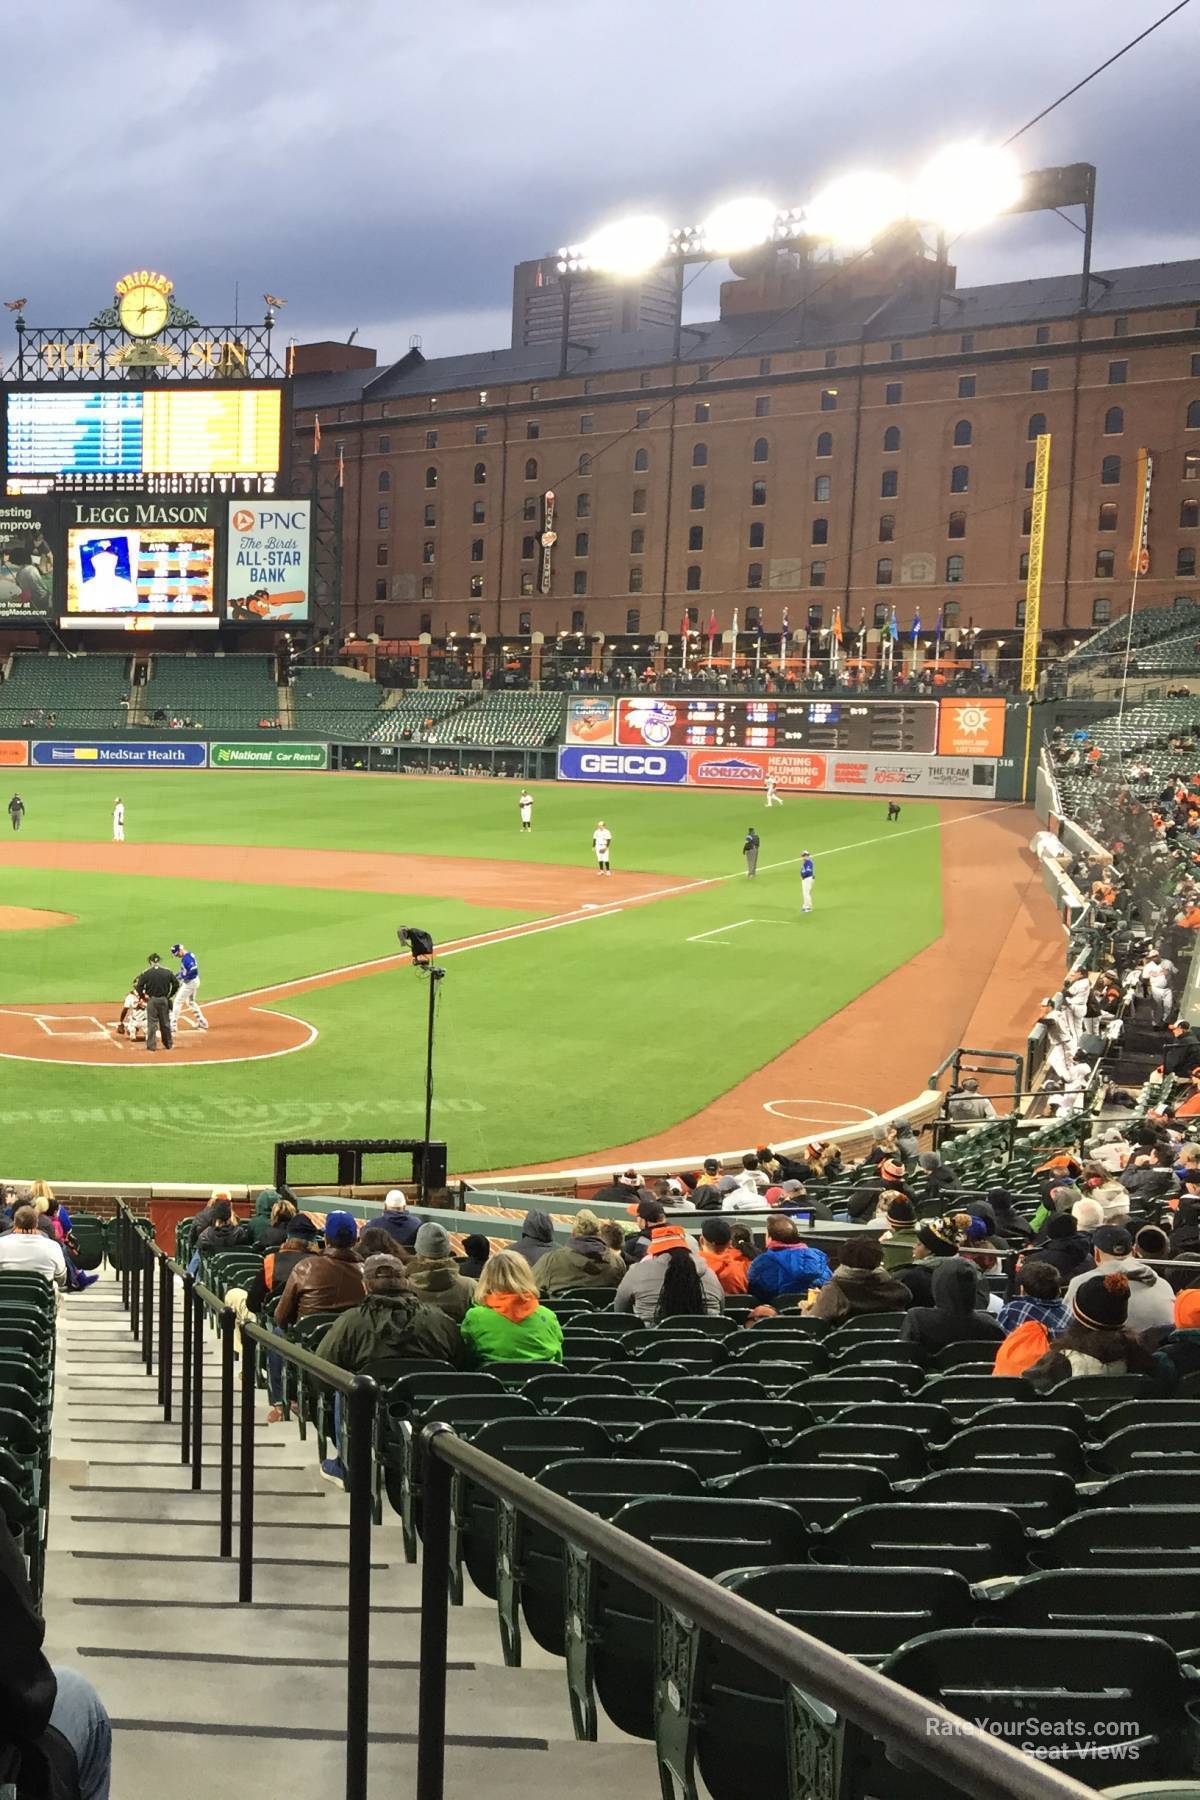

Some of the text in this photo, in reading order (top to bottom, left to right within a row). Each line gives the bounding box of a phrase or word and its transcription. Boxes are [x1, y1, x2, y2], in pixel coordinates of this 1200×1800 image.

[115, 270, 174, 295] ORIOLES
[41, 341, 247, 369] THE SUN
[75, 504, 208, 524] LEGG MASON
[259, 512, 307, 530] PNC
[240, 536, 298, 549] The Birds
[236, 551, 301, 566] ALL-STAR
[250, 568, 285, 583] BANK
[100, 750, 185, 760] MedStar Health
[230, 750, 320, 761] National Car Rental
[768, 756, 812, 767] HEATING
[580, 754, 667, 775] GEICO
[998, 759, 1014, 767] 318
[699, 766, 762, 780] HORIZON
[767, 766, 819, 776] PLUMBING
[928, 767, 945, 777] THE
[946, 767, 970, 778] TEAM
